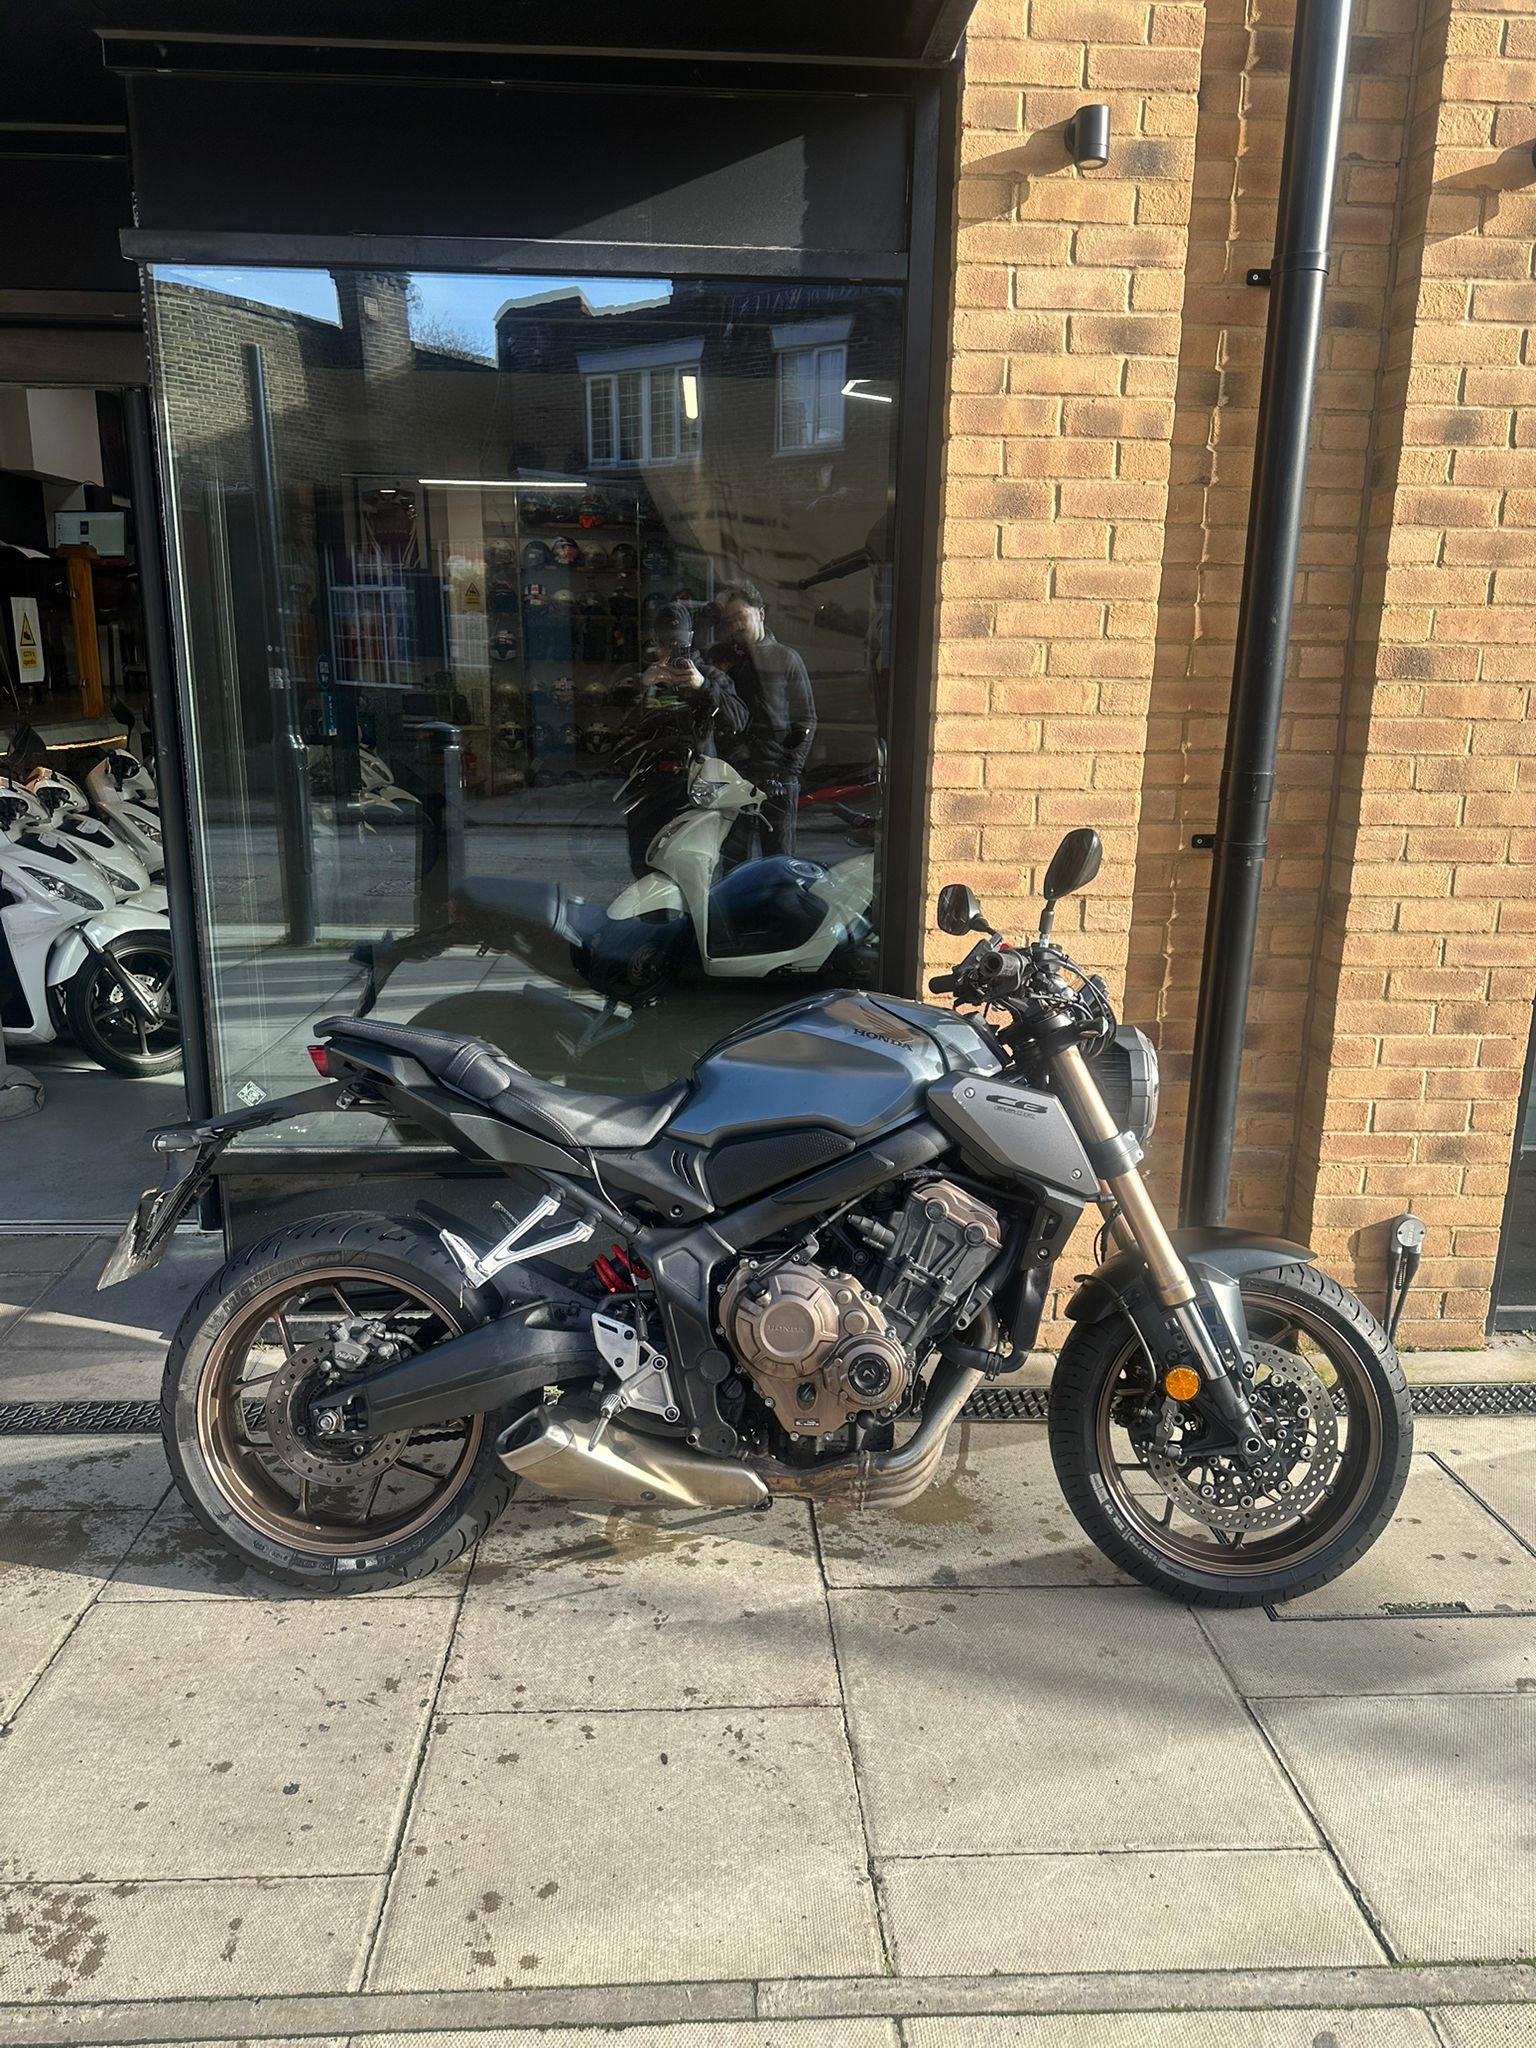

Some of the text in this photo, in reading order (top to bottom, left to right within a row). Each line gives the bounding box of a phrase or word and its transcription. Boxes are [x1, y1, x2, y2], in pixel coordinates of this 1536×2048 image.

[853, 1028, 913, 1052] HONDA
[986, 1095, 1048, 1113] CB
[223, 1256, 300, 1312] MICHELIN
[767, 1323, 806, 1334] HONDA
[1104, 1503, 1115, 1515] 17
[1128, 1535, 1158, 1563] 120/70
